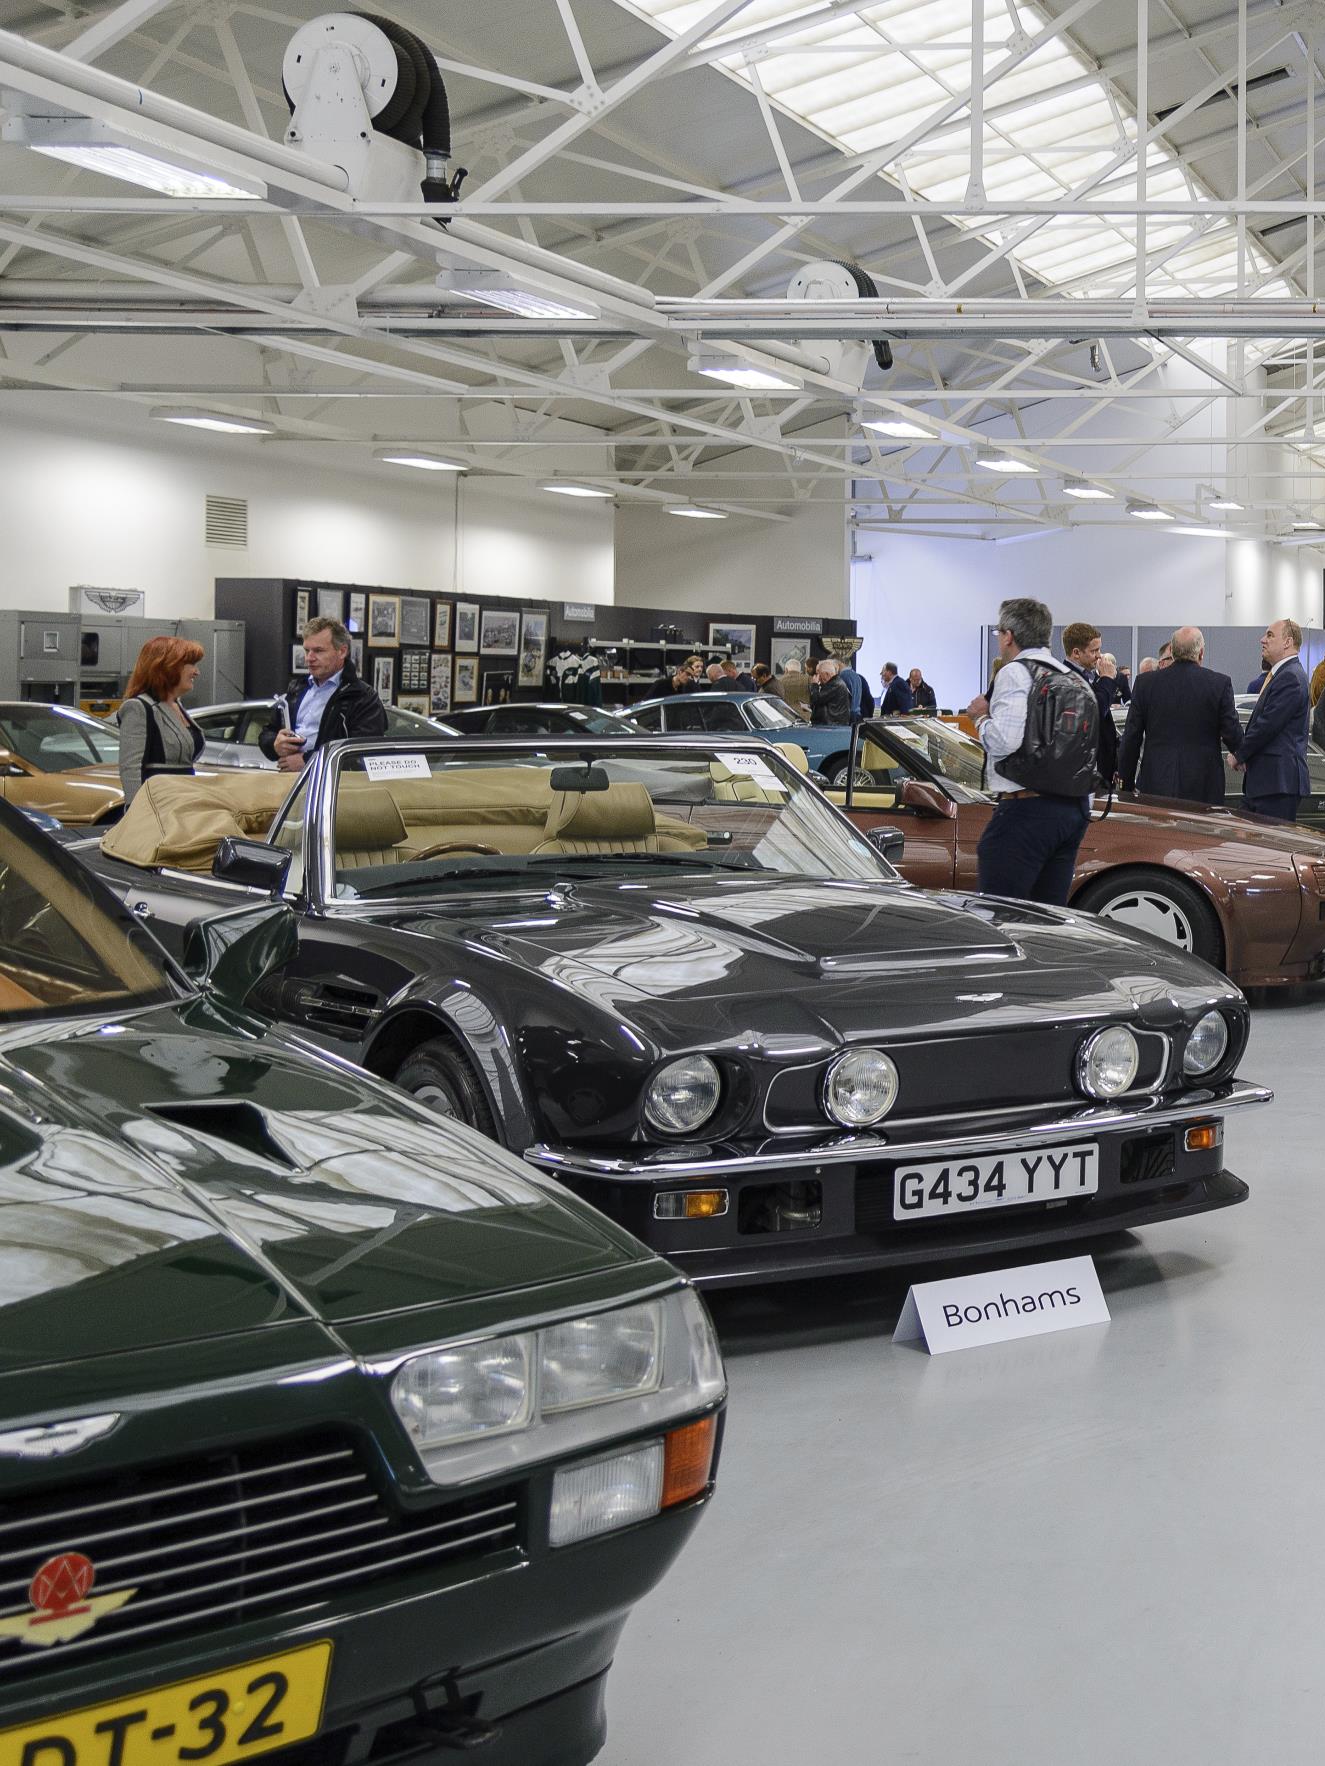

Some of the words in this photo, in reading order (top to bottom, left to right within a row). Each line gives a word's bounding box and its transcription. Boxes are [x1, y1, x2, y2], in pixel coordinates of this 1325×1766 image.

[776, 620, 821, 632] Automobilia
[899, 1160, 1007, 1211] G434
[1020, 1149, 1095, 1194] YYT
[942, 1286, 1082, 1328] Bonhams
